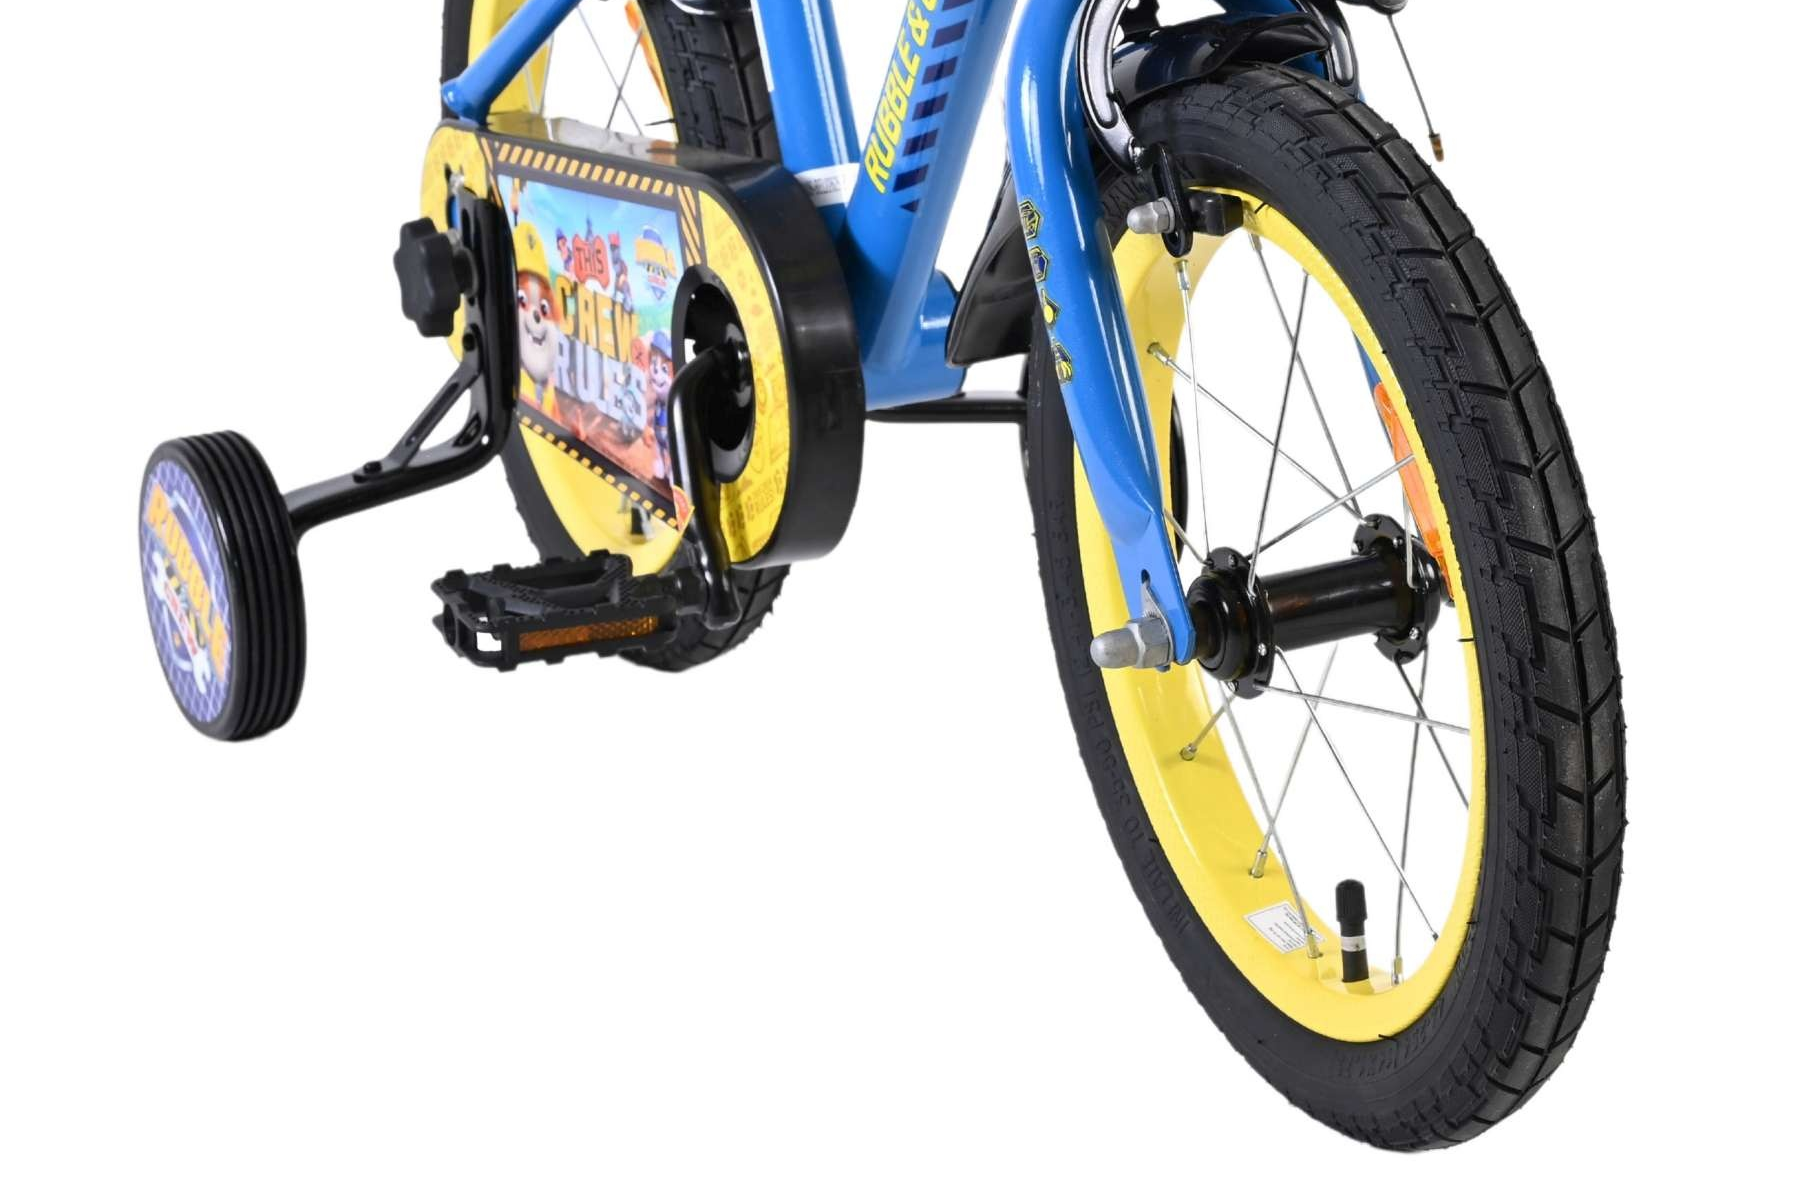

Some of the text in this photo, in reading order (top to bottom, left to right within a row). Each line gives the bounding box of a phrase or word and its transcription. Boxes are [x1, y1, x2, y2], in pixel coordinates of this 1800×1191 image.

[863, 26, 921, 194] RUBBLE
[906, 0, 930, 48] &
[576, 246, 605, 277] THIS
[555, 274, 639, 363] CREW
[553, 331, 648, 434] RULES
